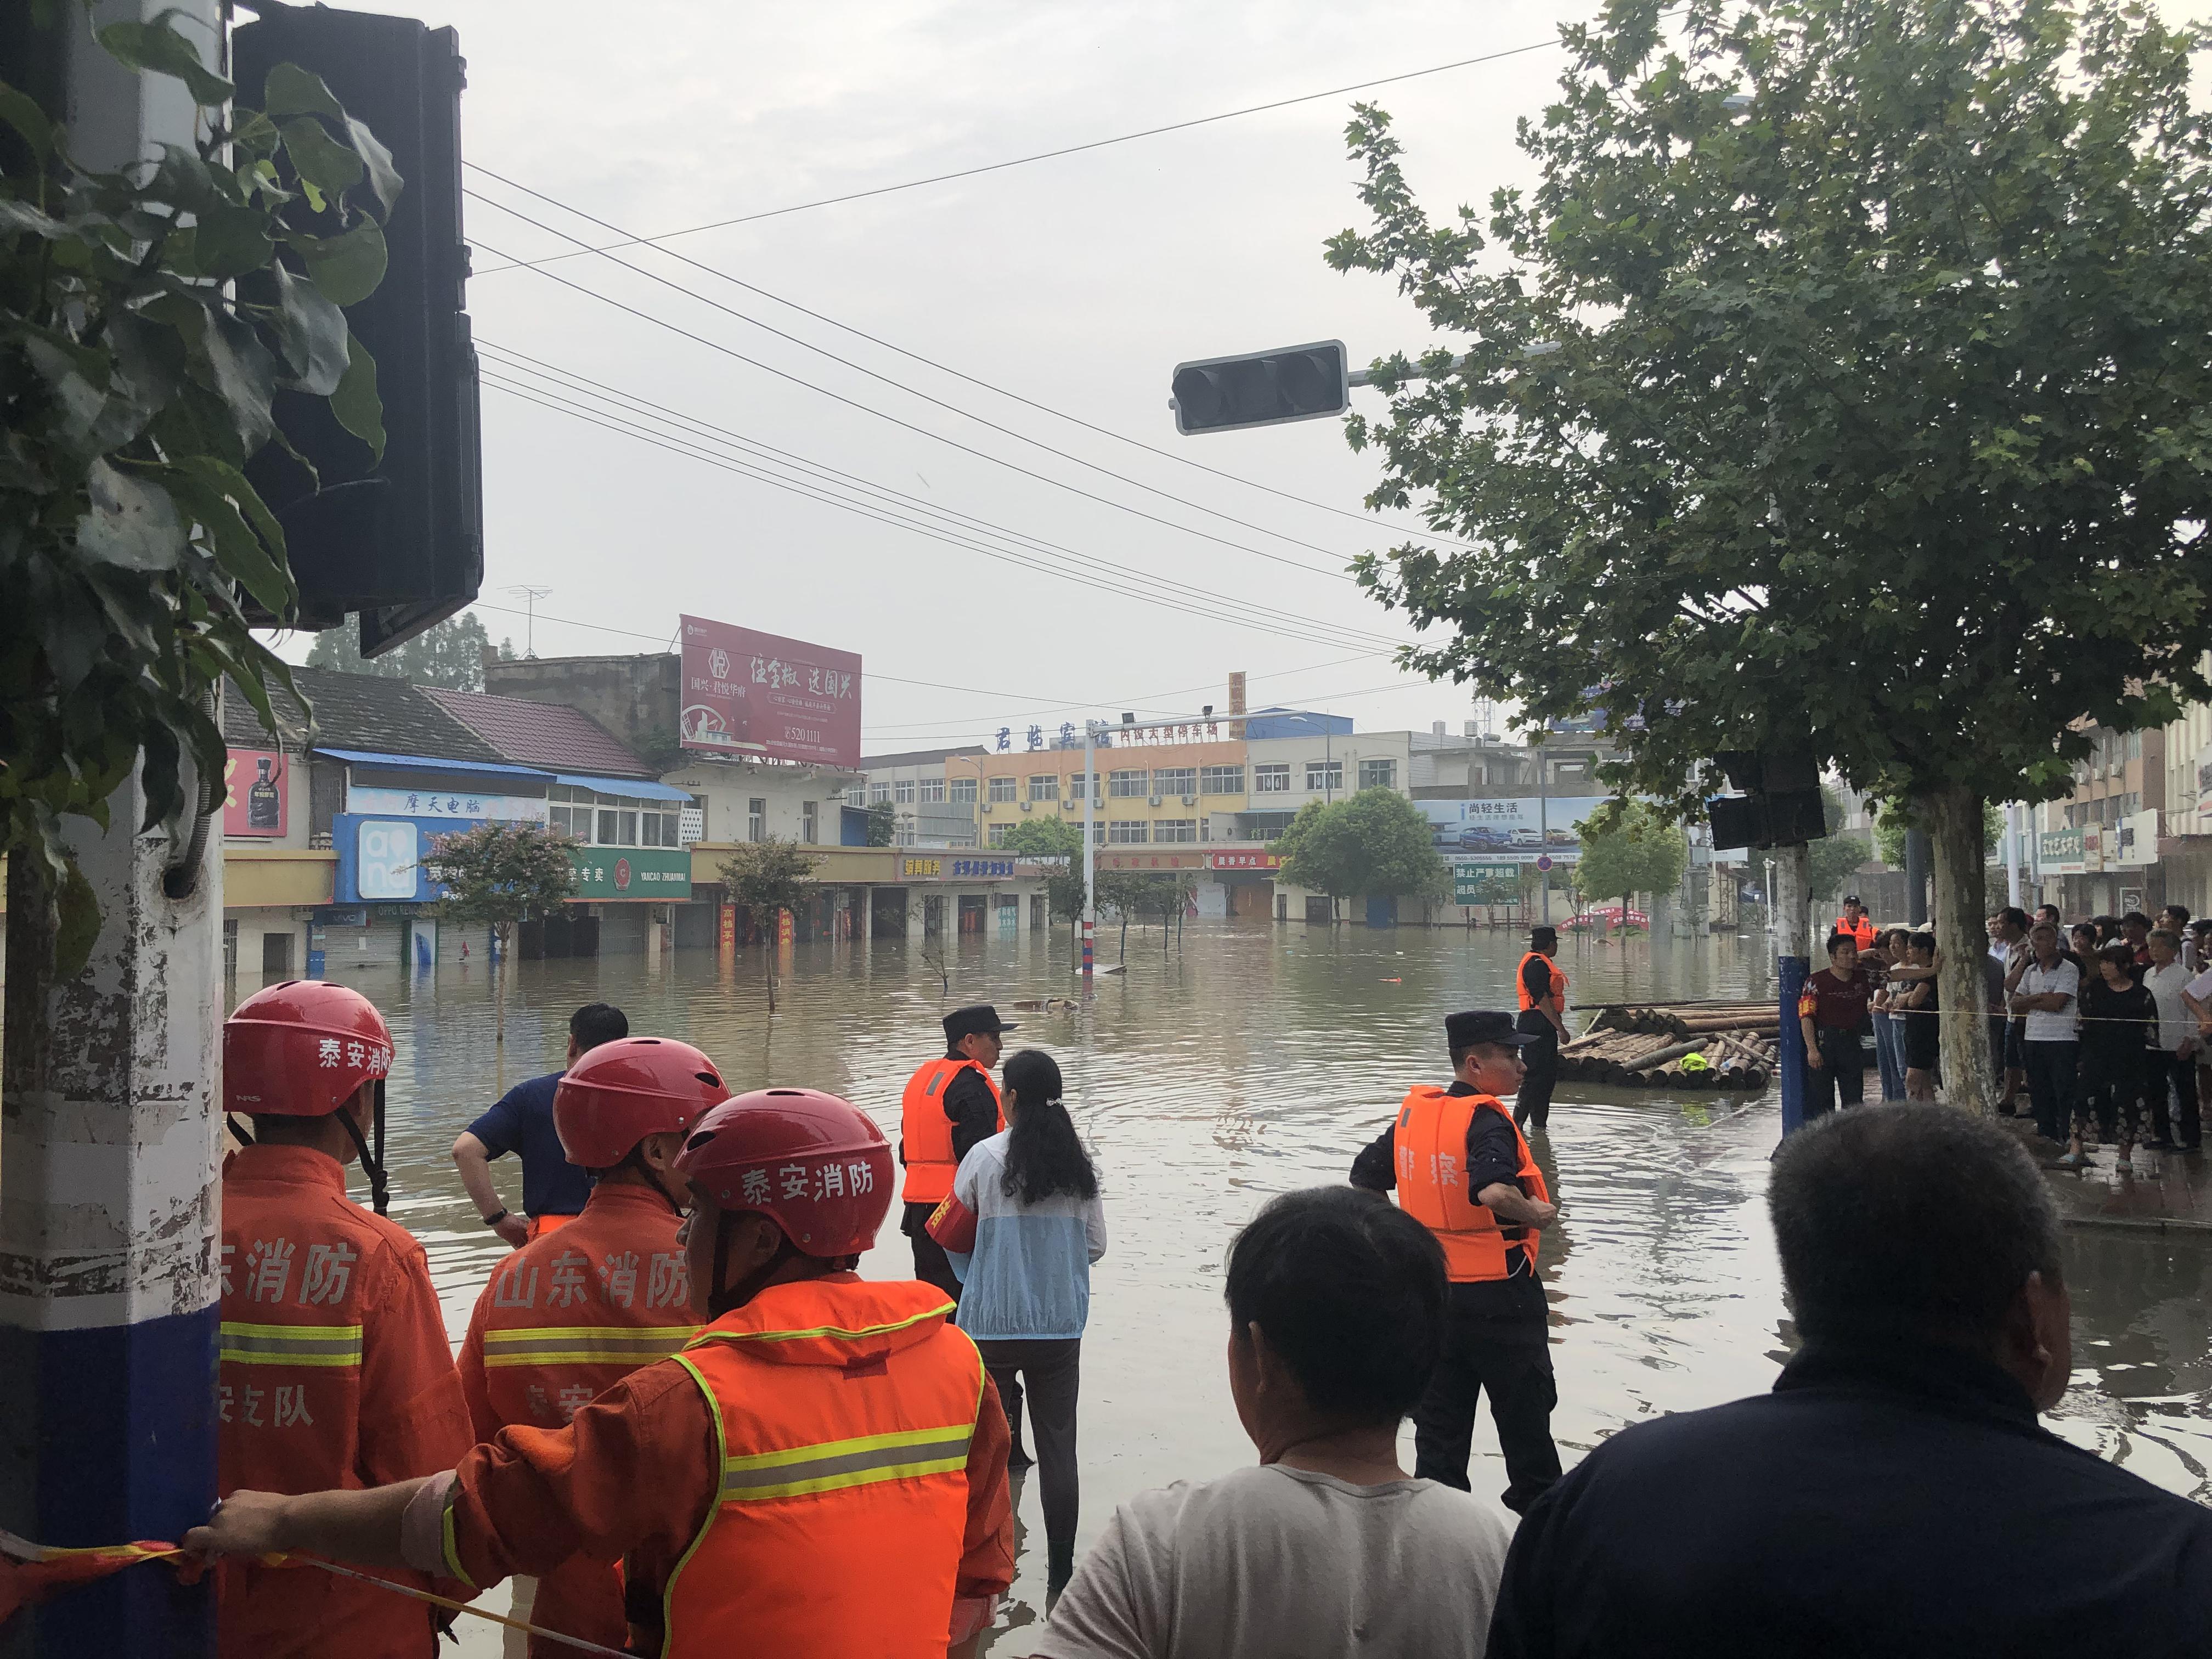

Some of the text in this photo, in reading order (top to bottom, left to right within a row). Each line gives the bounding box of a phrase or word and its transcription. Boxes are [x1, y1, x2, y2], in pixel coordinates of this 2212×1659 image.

[1120, 723, 1218, 741] 内设大型停车场
[403, 793, 481, 814] 摩天电脑
[1469, 803, 1518, 814] 尚轻生活
[1217, 856, 1256, 866] 晨香早点
[556, 867, 603, 882] 草专卖
[640, 872, 686, 882] YANCAO ZHUANMAI
[1456, 868, 1515, 878] 禁止严重超载
[319, 1038, 392, 1076] 泰安消防
[741, 1160, 873, 1206] 泰安消防
[494, 1250, 690, 1309] 山东消防
